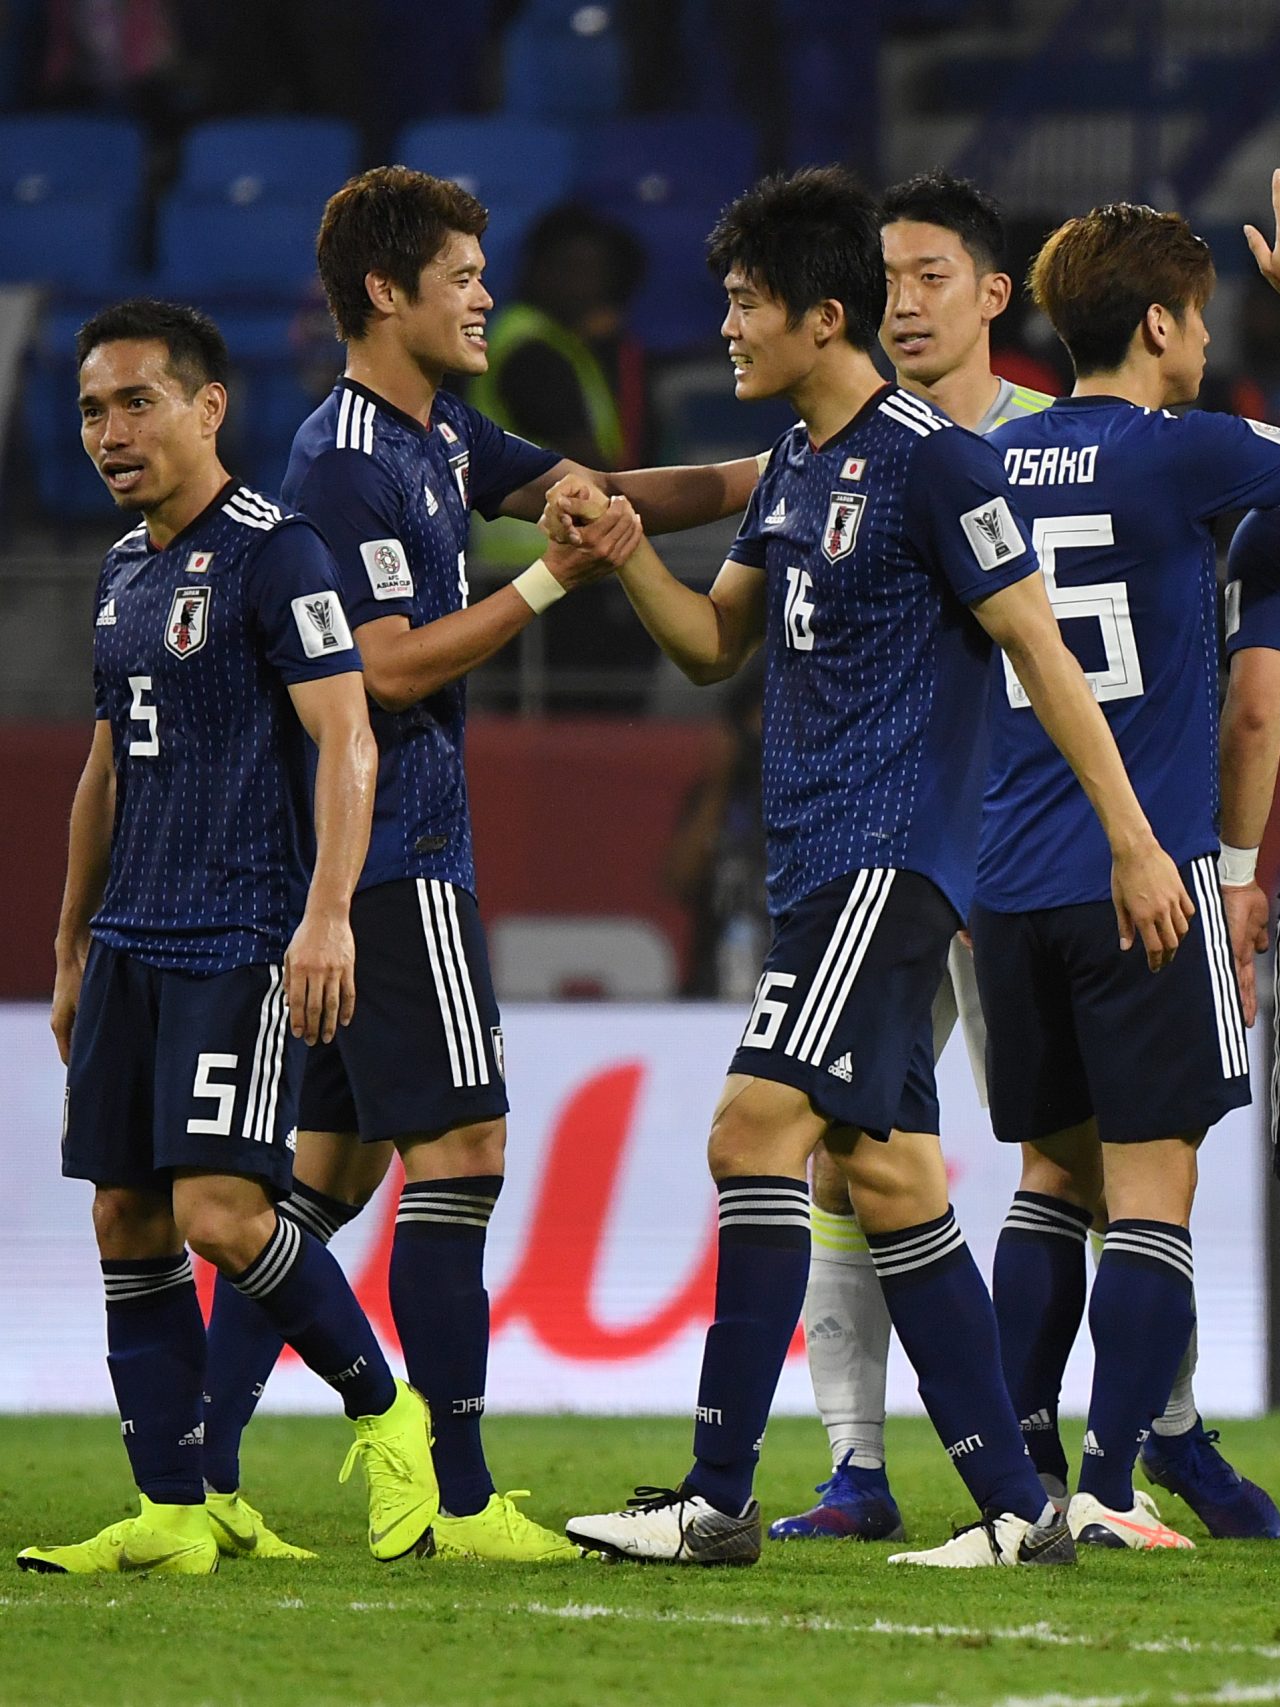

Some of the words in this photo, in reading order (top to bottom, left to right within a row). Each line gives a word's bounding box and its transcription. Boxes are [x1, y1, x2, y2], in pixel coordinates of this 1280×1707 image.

[1004, 445, 1099, 486] OSAKO
[376, 581, 399, 590] ASIAN
[783, 565, 816, 651] 16
[1001, 512, 1144, 709] 5
[128, 675, 159, 757] 5
[741, 971, 798, 1050] 6
[187, 1052, 239, 1136] 5
[827, 1064, 853, 1083] adidas
